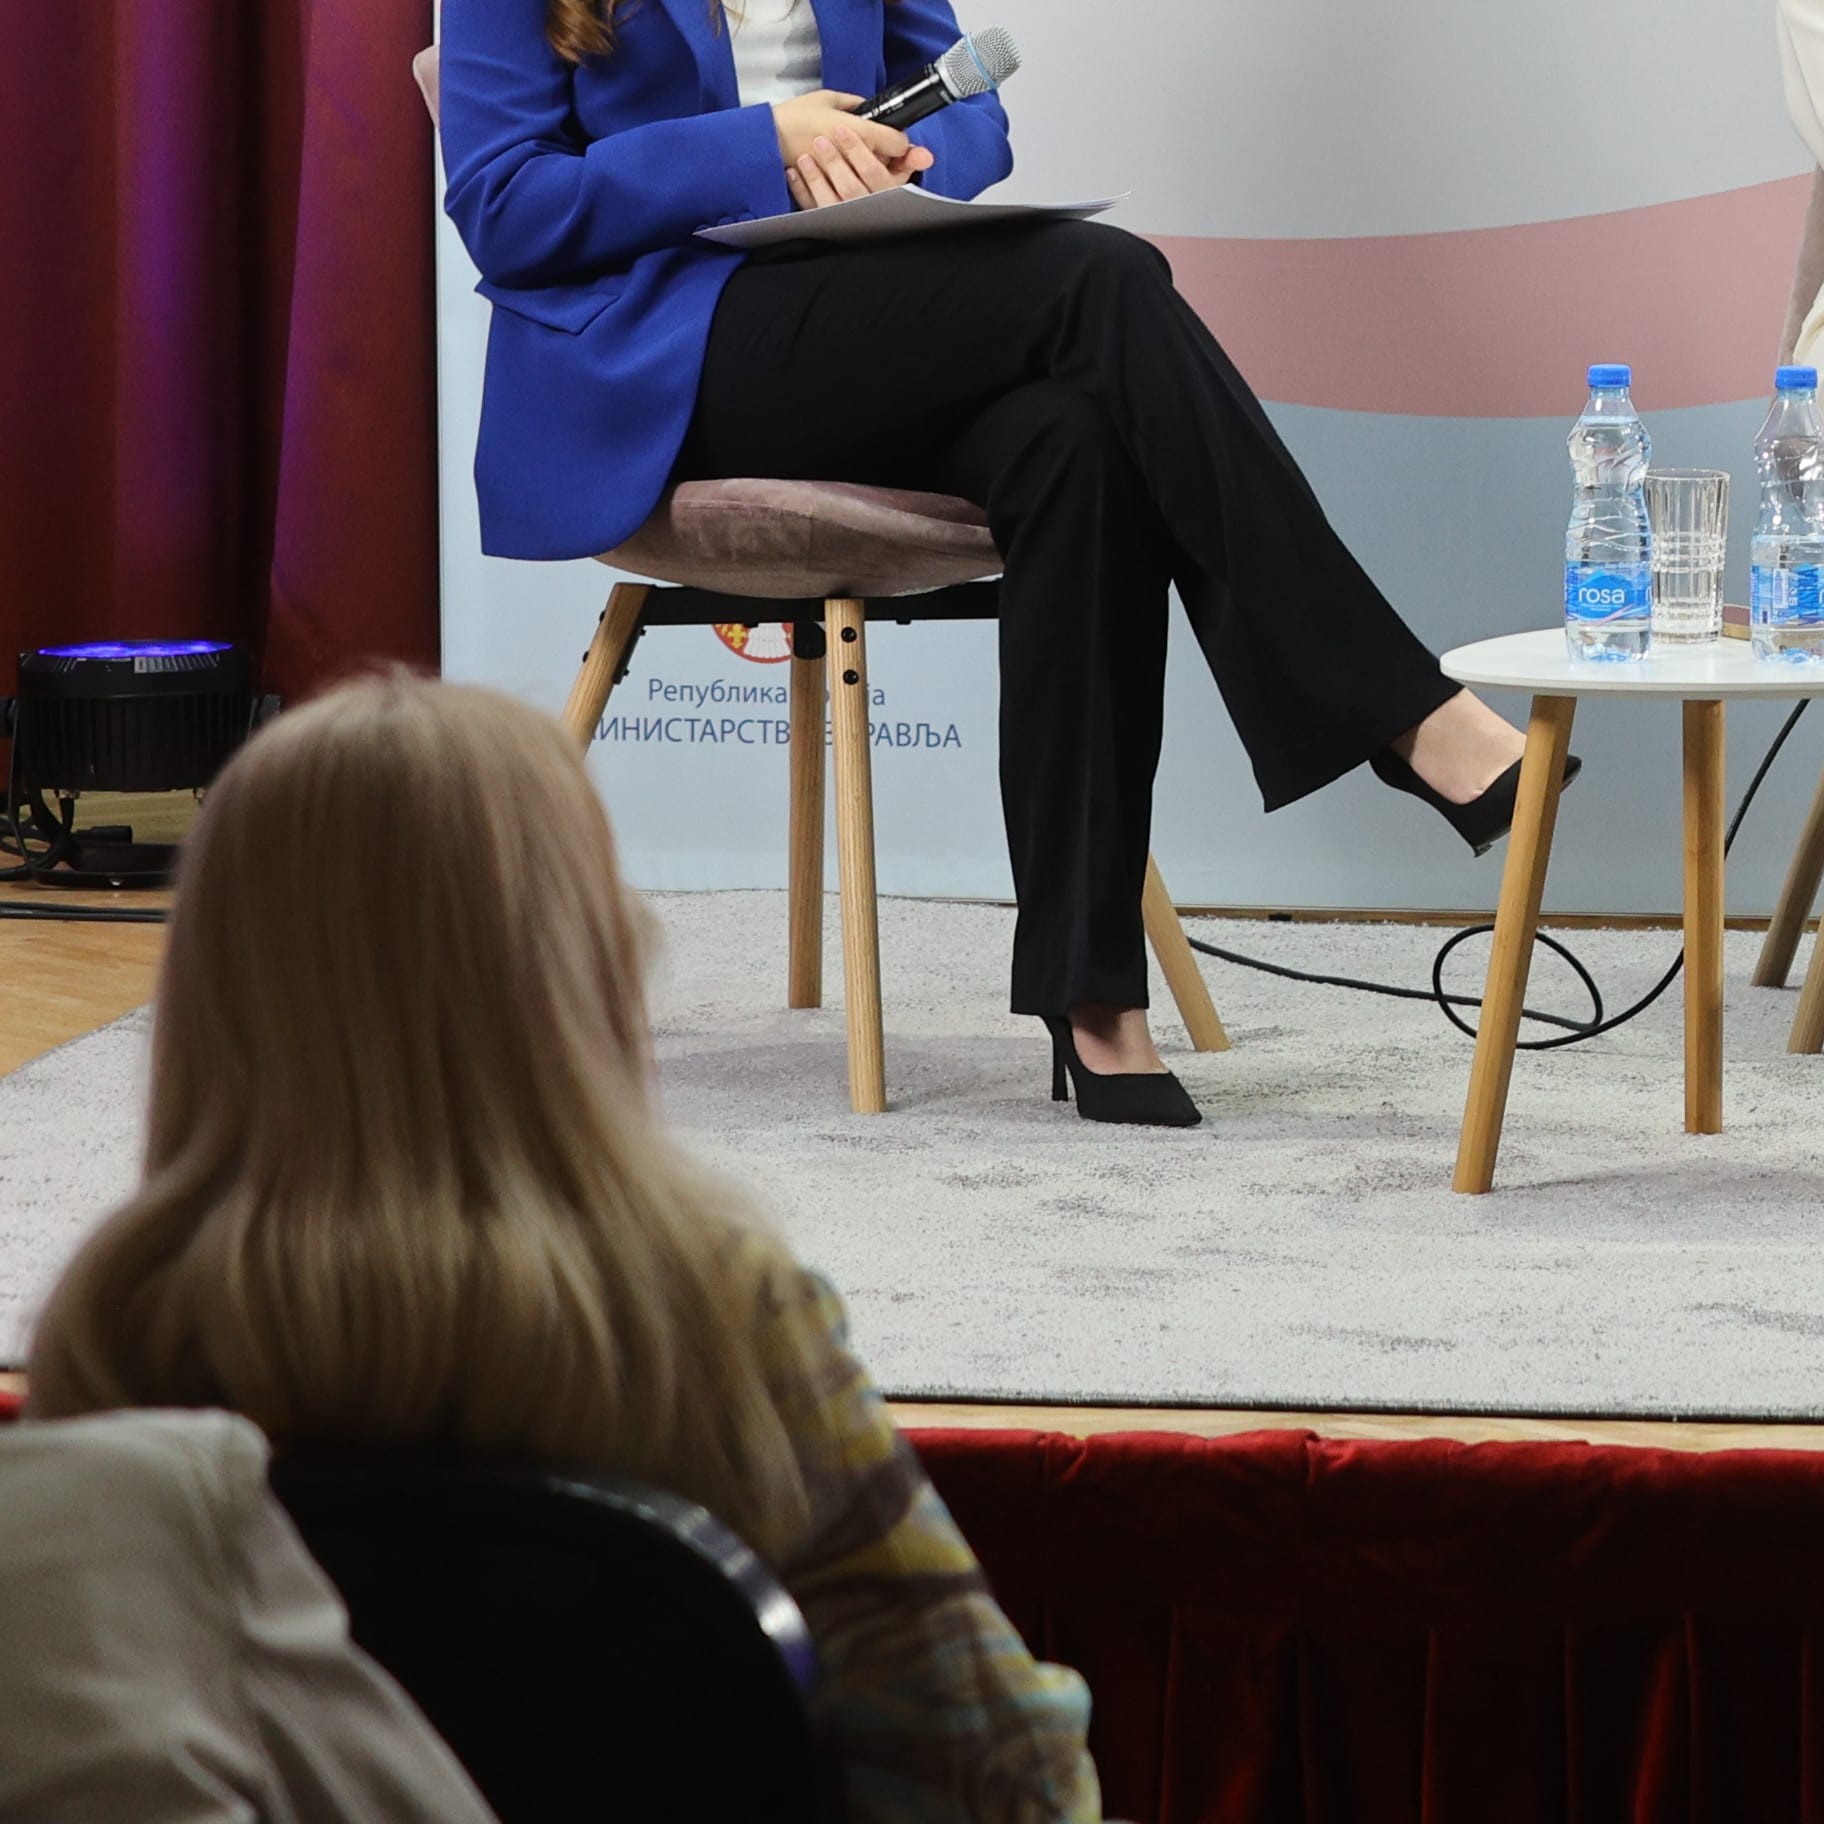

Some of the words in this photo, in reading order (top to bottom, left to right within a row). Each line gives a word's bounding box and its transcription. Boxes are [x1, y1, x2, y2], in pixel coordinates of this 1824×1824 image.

[1578, 587, 1626, 604] rosa
[648, 678, 788, 708] Република
[592, 716, 790, 745] ИНИСТАРСТВ
